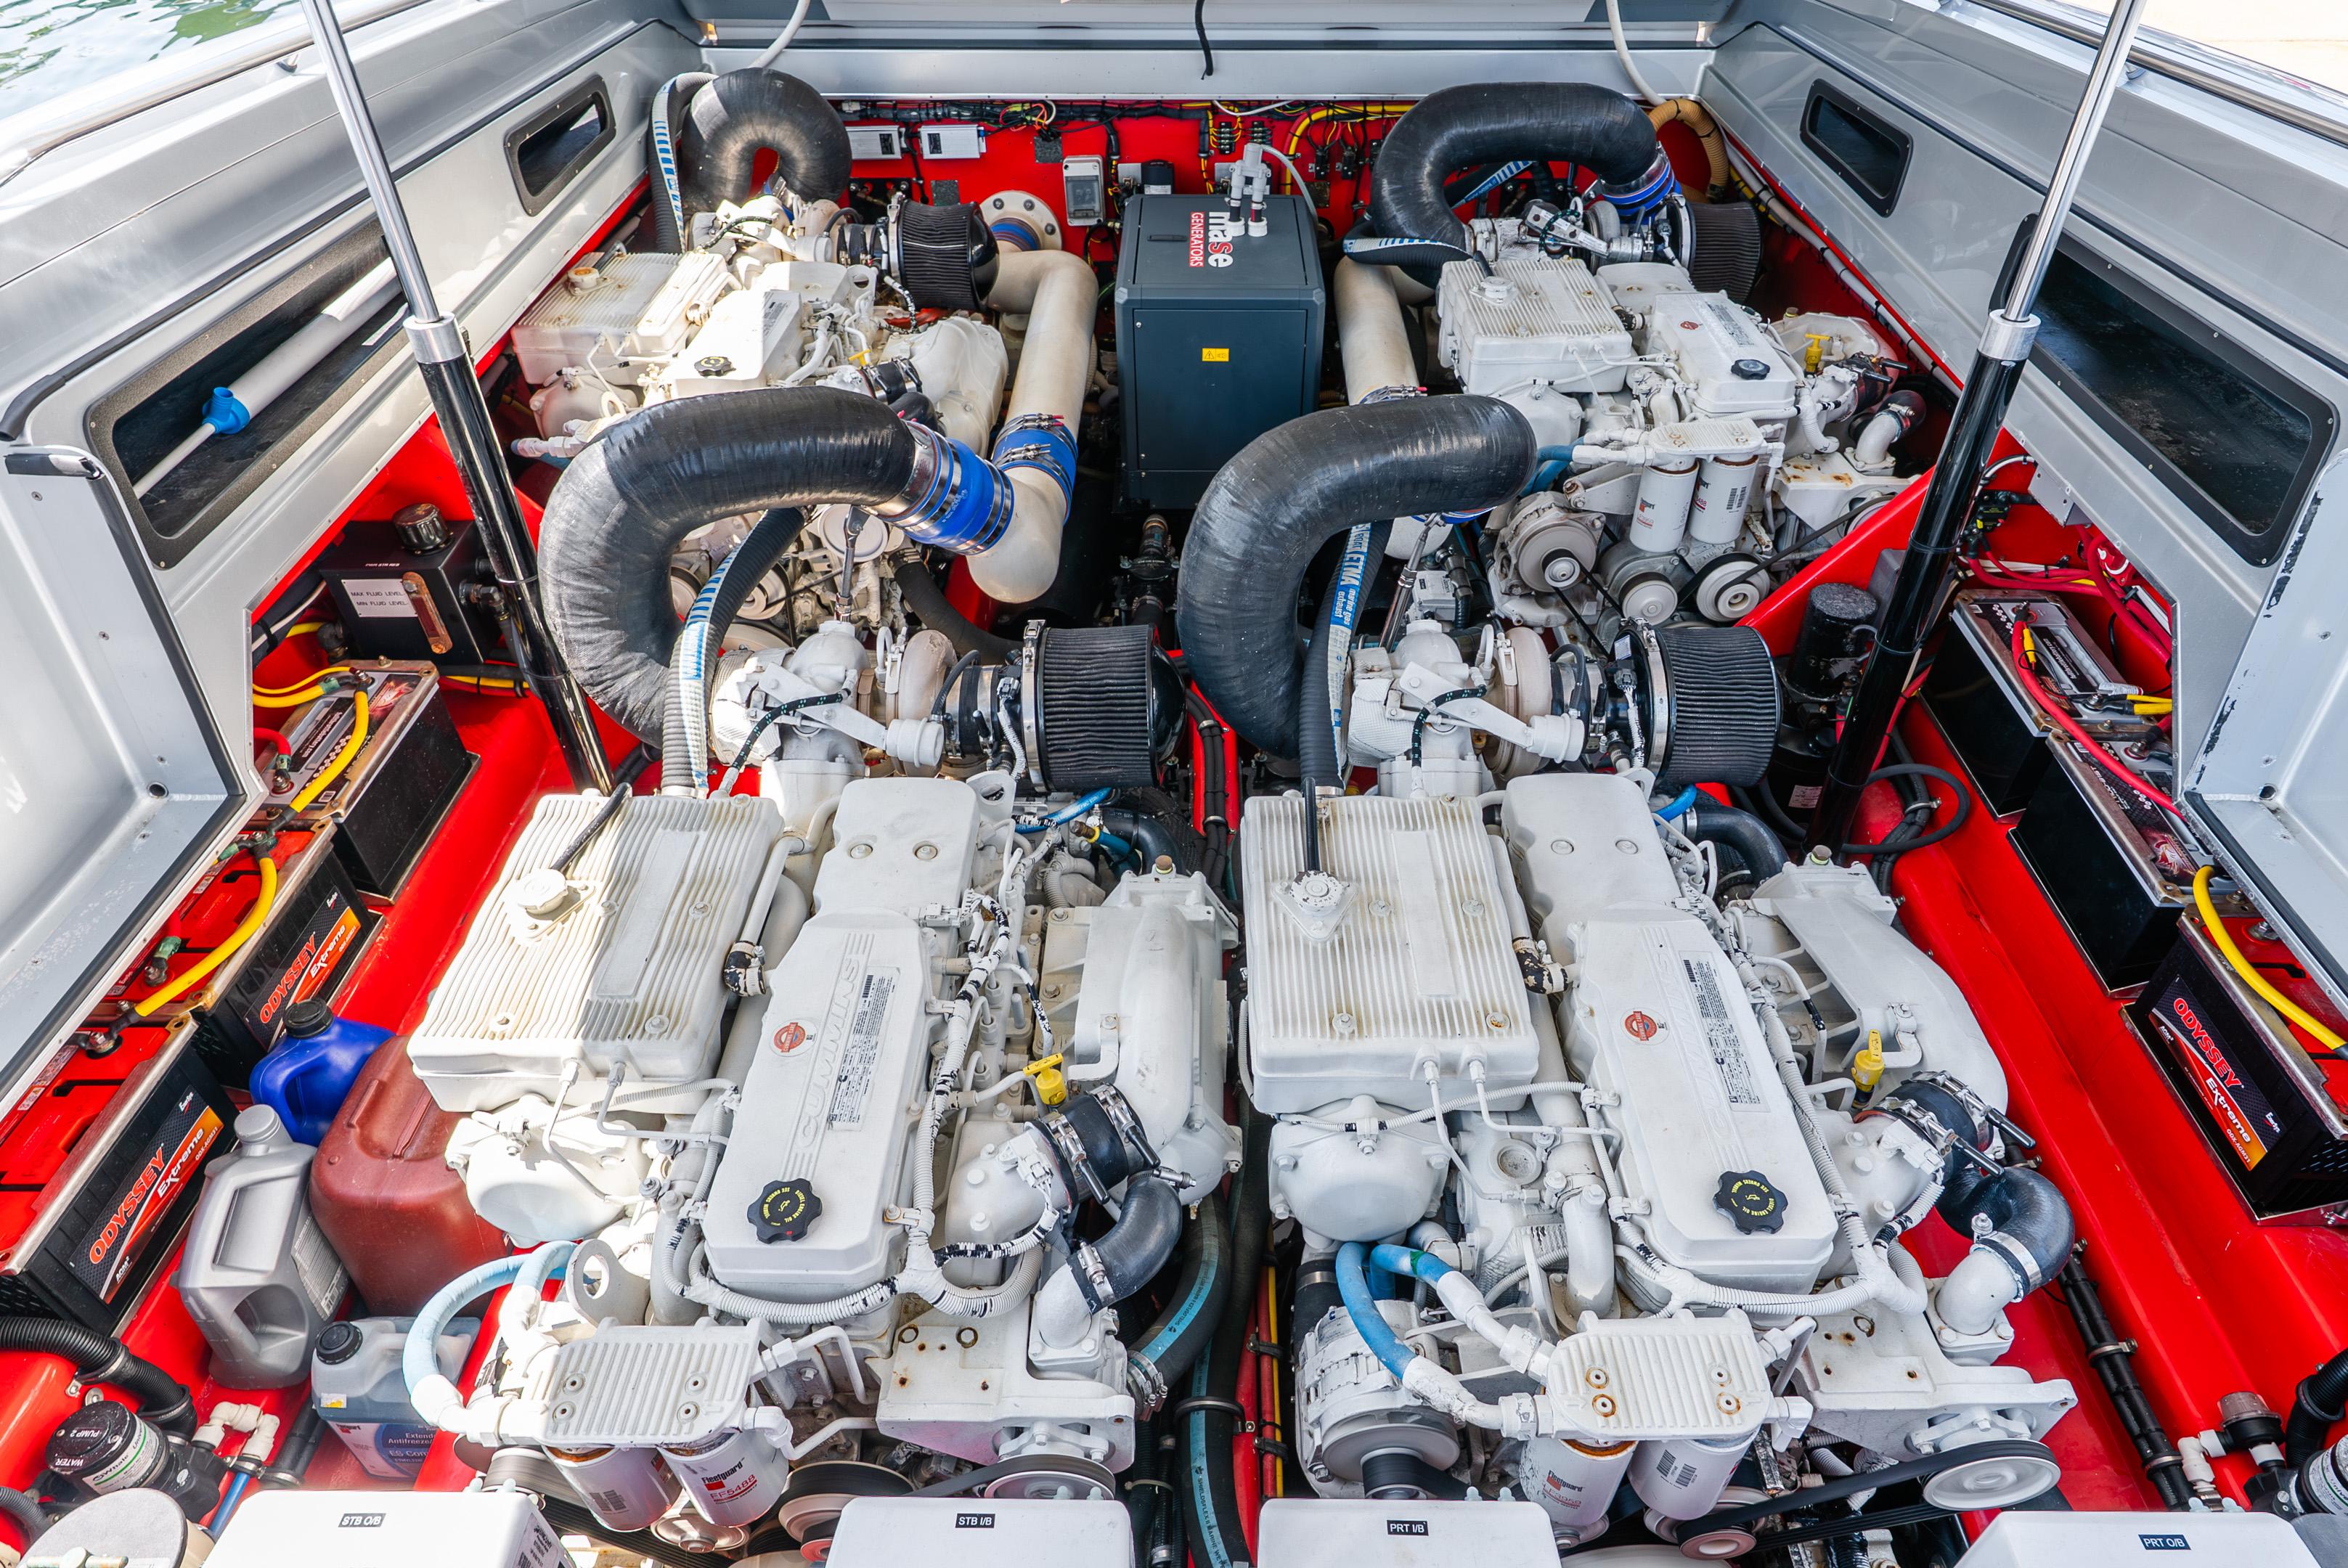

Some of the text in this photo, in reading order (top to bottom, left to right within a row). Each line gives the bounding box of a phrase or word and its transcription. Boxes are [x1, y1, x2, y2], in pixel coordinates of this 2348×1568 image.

[1190, 212, 1204, 266] GENERATORS
[1208, 212, 1233, 267] mase
[1340, 553, 1365, 586] ETNA
[1334, 591, 1345, 618] exhaust
[1344, 588, 1356, 625] marine gas
[310, 925, 346, 978] Extreme
[260, 934, 317, 1024] ODYSSEY
[801, 957, 860, 1148] CUMMINS
[2174, 997, 2242, 1087] ODYSSEY
[2206, 1077, 2251, 1143] Extreme
[195, 1127, 219, 1161] ODX-AGM31
[2226, 1129, 2251, 1163] ODX-AGM31
[157, 1127, 204, 1199] Extreme
[89, 1146, 166, 1265] ODYSSEY
[55, 1457, 83, 1466] WATER
[702, 1460, 743, 1484] Fleetguard
[710, 1474, 756, 1500] FF5488
[1548, 1469, 1583, 1493] Fleetguard
[1197, 1478, 1210, 1520] SHIELDSFLEX
[341, 1515, 382, 1526] STB O/B
[958, 1516, 992, 1526] STB I/B
[1390, 1523, 1424, 1533] PRT I/B
[2143, 1538, 2185, 1548] PRT O/B
